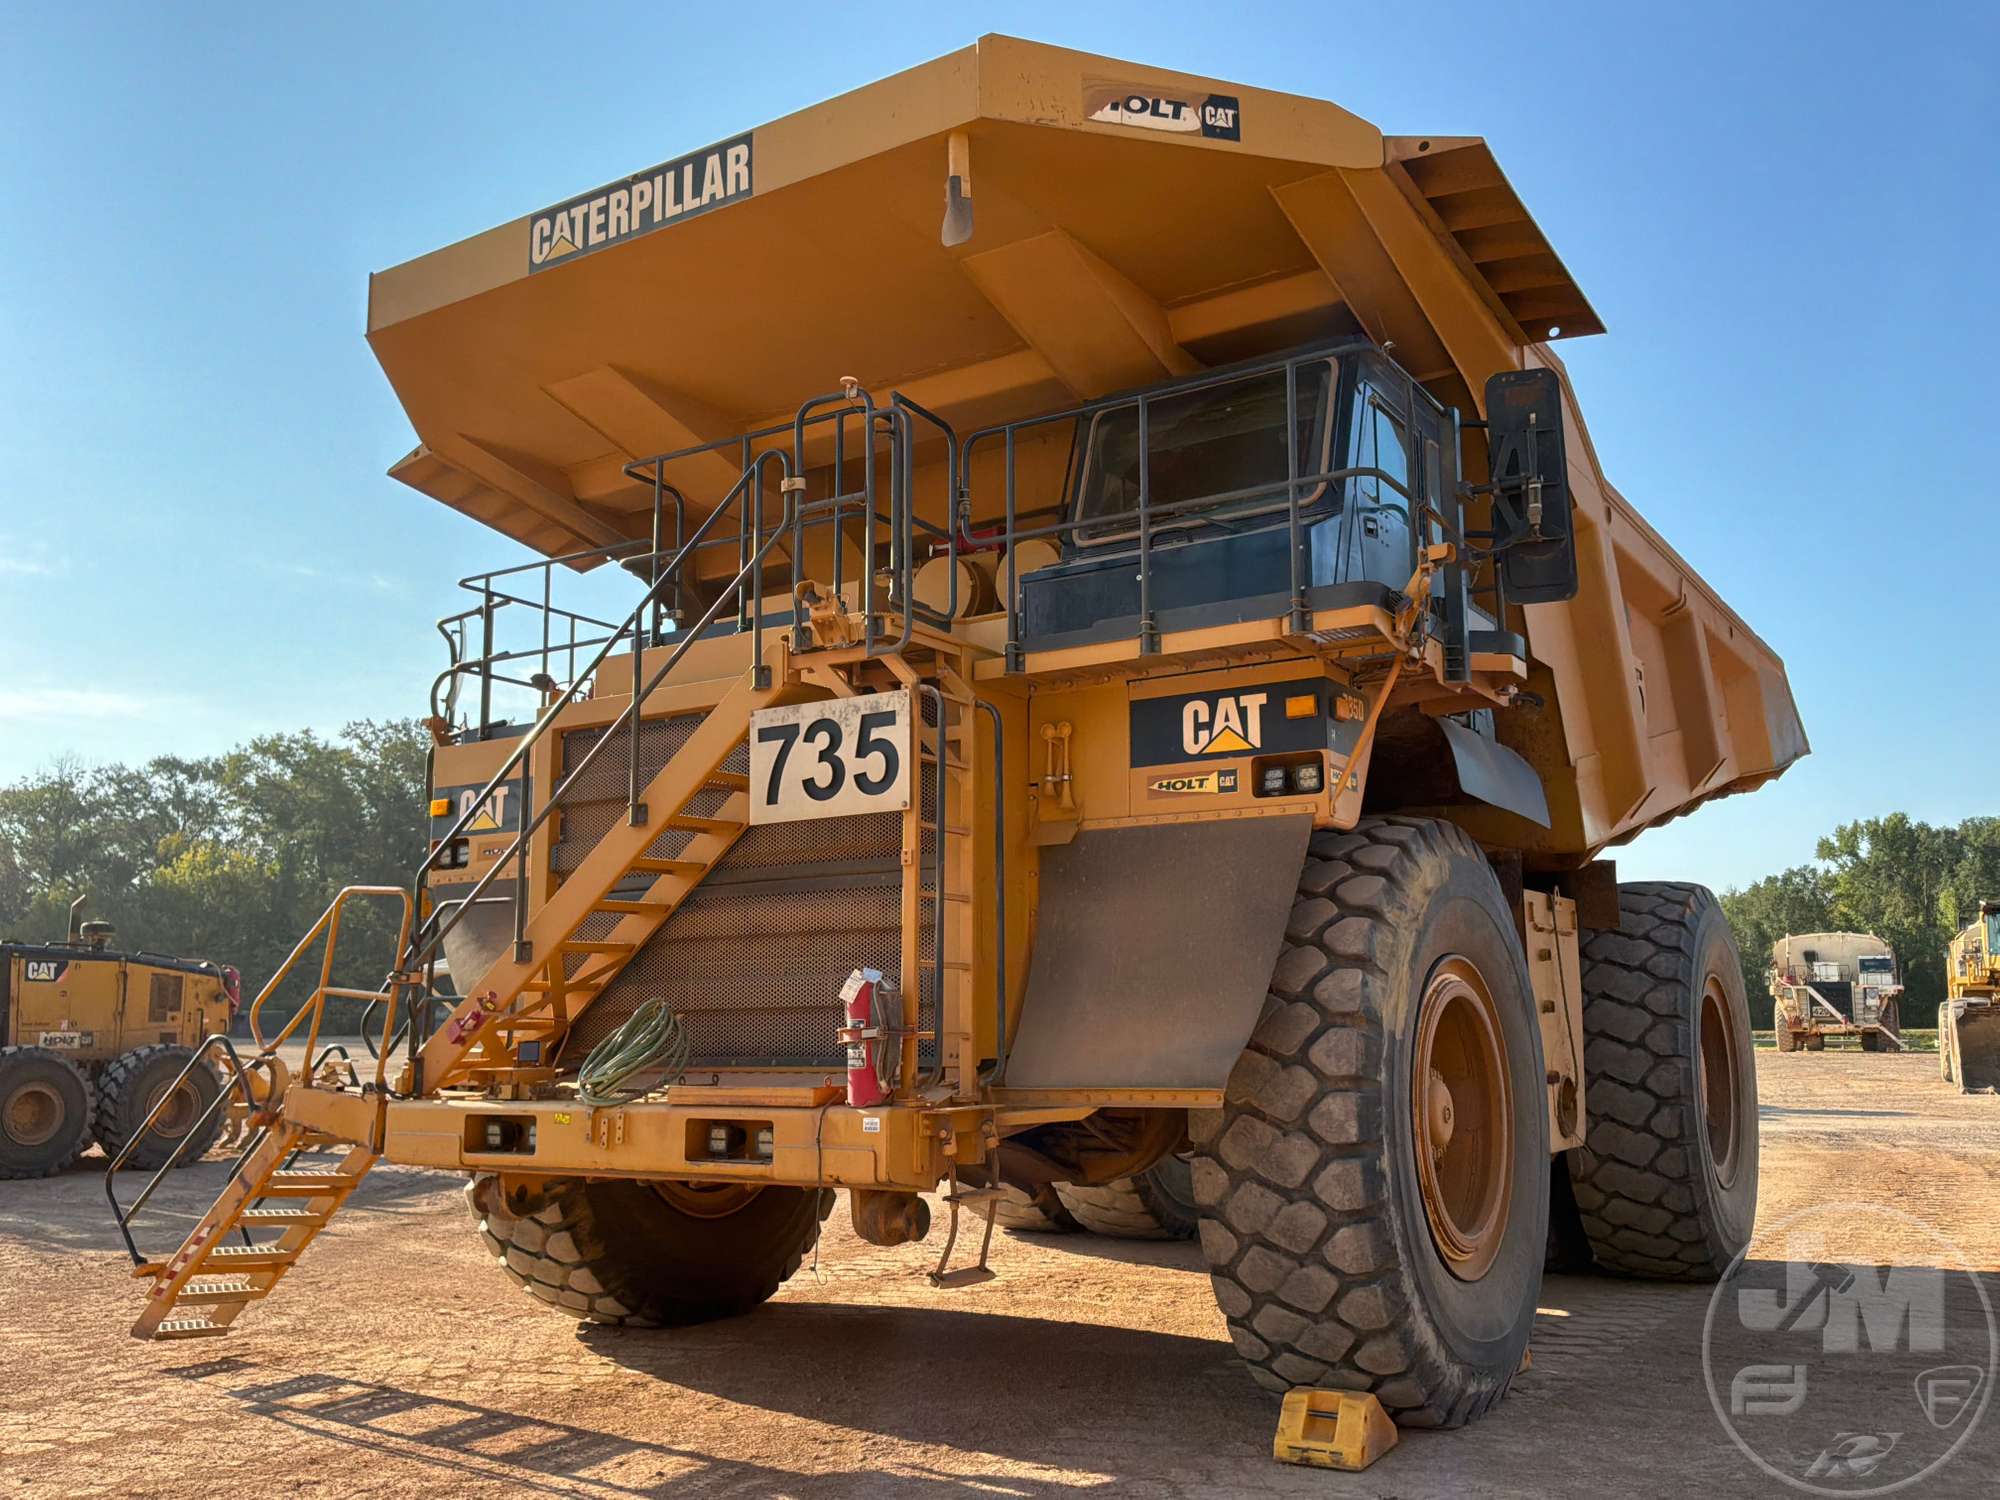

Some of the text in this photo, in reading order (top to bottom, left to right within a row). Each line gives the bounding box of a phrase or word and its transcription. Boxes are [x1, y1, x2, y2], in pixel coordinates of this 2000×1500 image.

[1205, 106, 1237, 128] CAT
[531, 143, 749, 264] CATERPILLAR
[1182, 692, 1267, 755] CAT
[758, 710, 900, 802] 735
[1158, 776, 1237, 790] HOLT CAT
[27, 962, 57, 980] CAT
